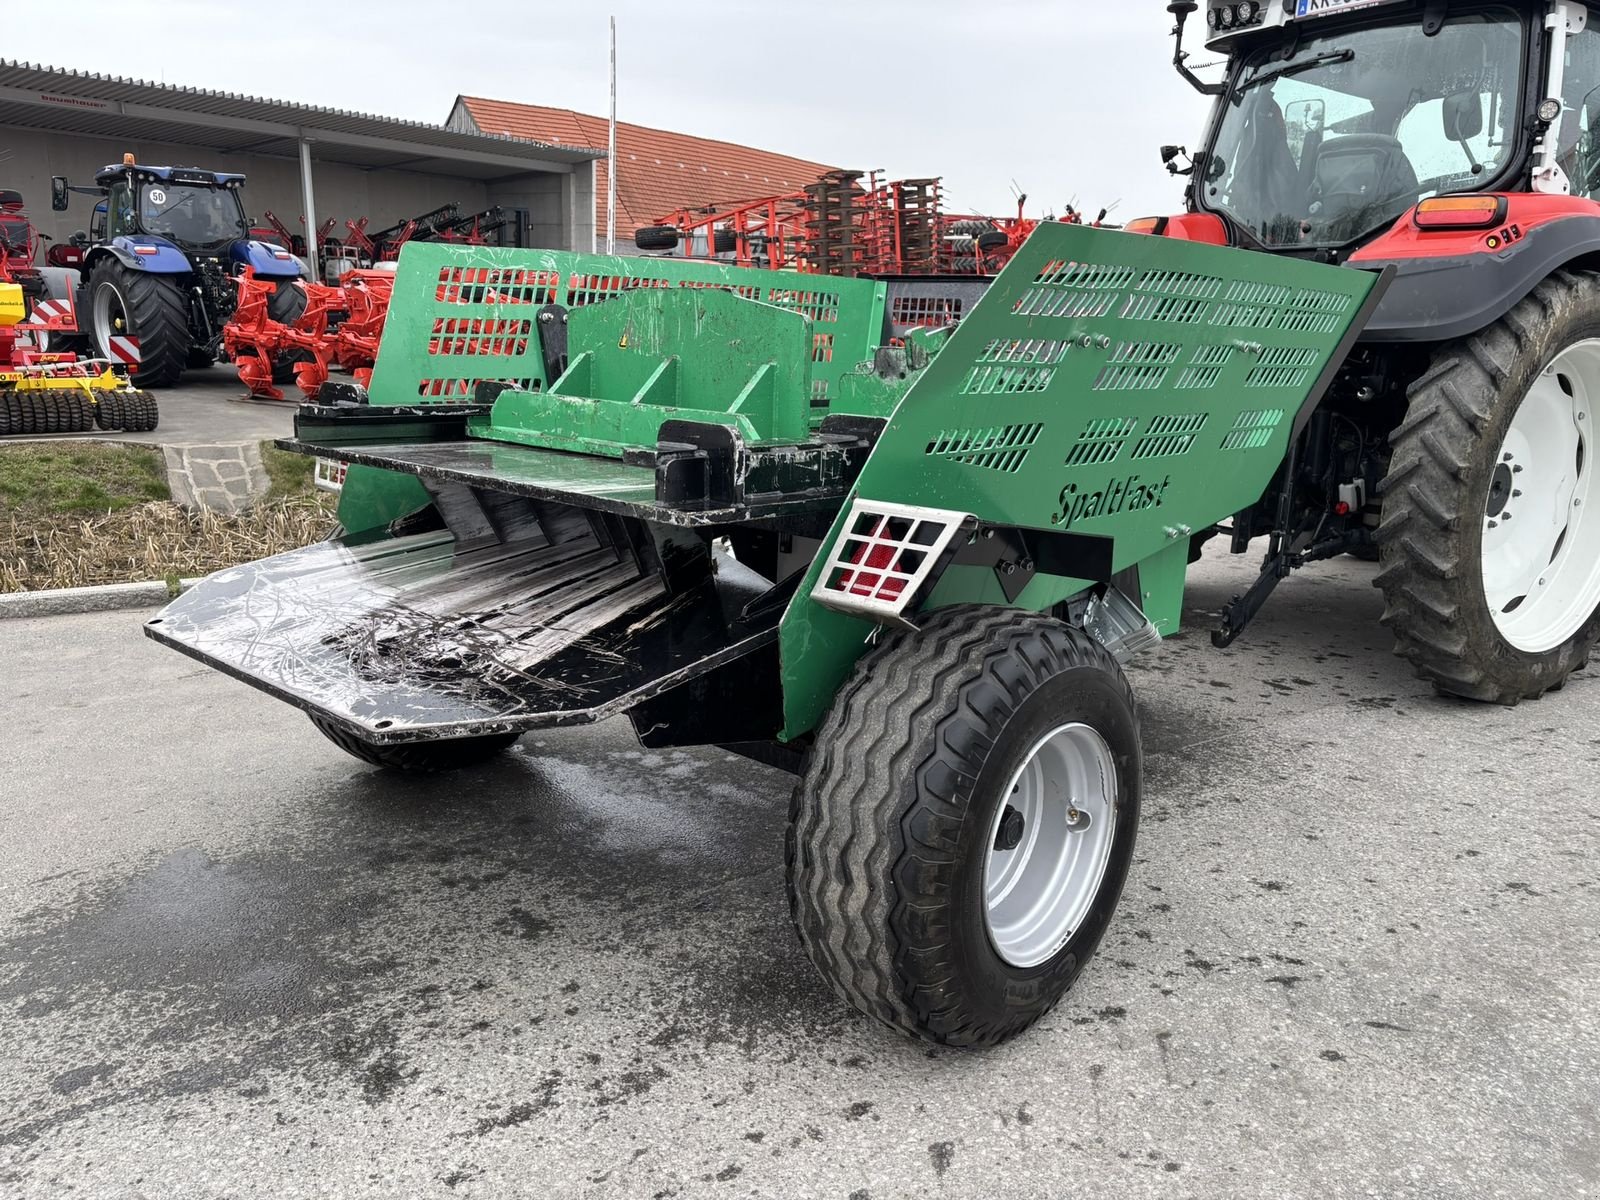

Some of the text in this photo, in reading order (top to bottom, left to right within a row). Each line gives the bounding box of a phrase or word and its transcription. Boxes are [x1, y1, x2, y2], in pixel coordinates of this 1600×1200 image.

[41, 95, 107, 107] baumhauer
[152, 191, 164, 202] 50
[1051, 475, 1170, 529] SpaltFast
